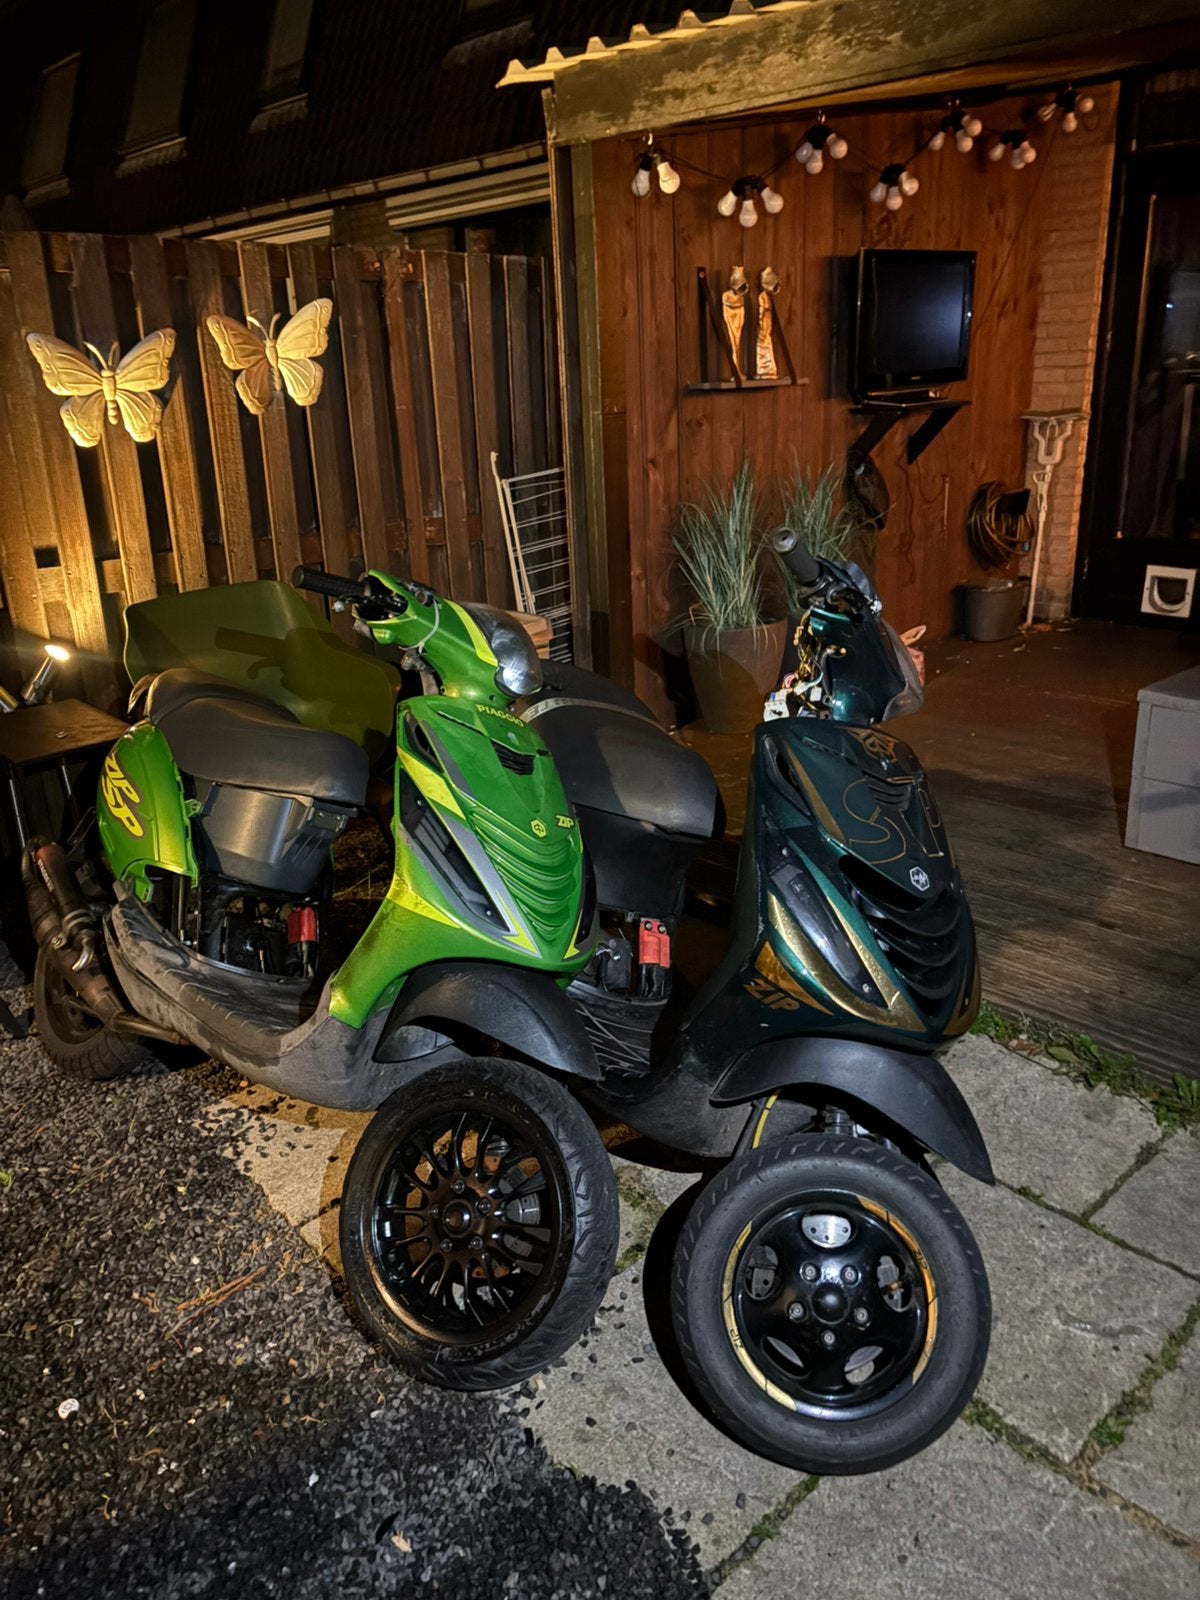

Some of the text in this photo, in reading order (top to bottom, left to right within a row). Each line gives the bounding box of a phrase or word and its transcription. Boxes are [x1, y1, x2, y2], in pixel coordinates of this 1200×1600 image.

[476, 704, 525, 728] PIAGGIO
[104, 753, 140, 804] ZIP
[101, 774, 144, 837] SP
[555, 815, 575, 829] ZIP
[741, 977, 801, 1012] ZIP
